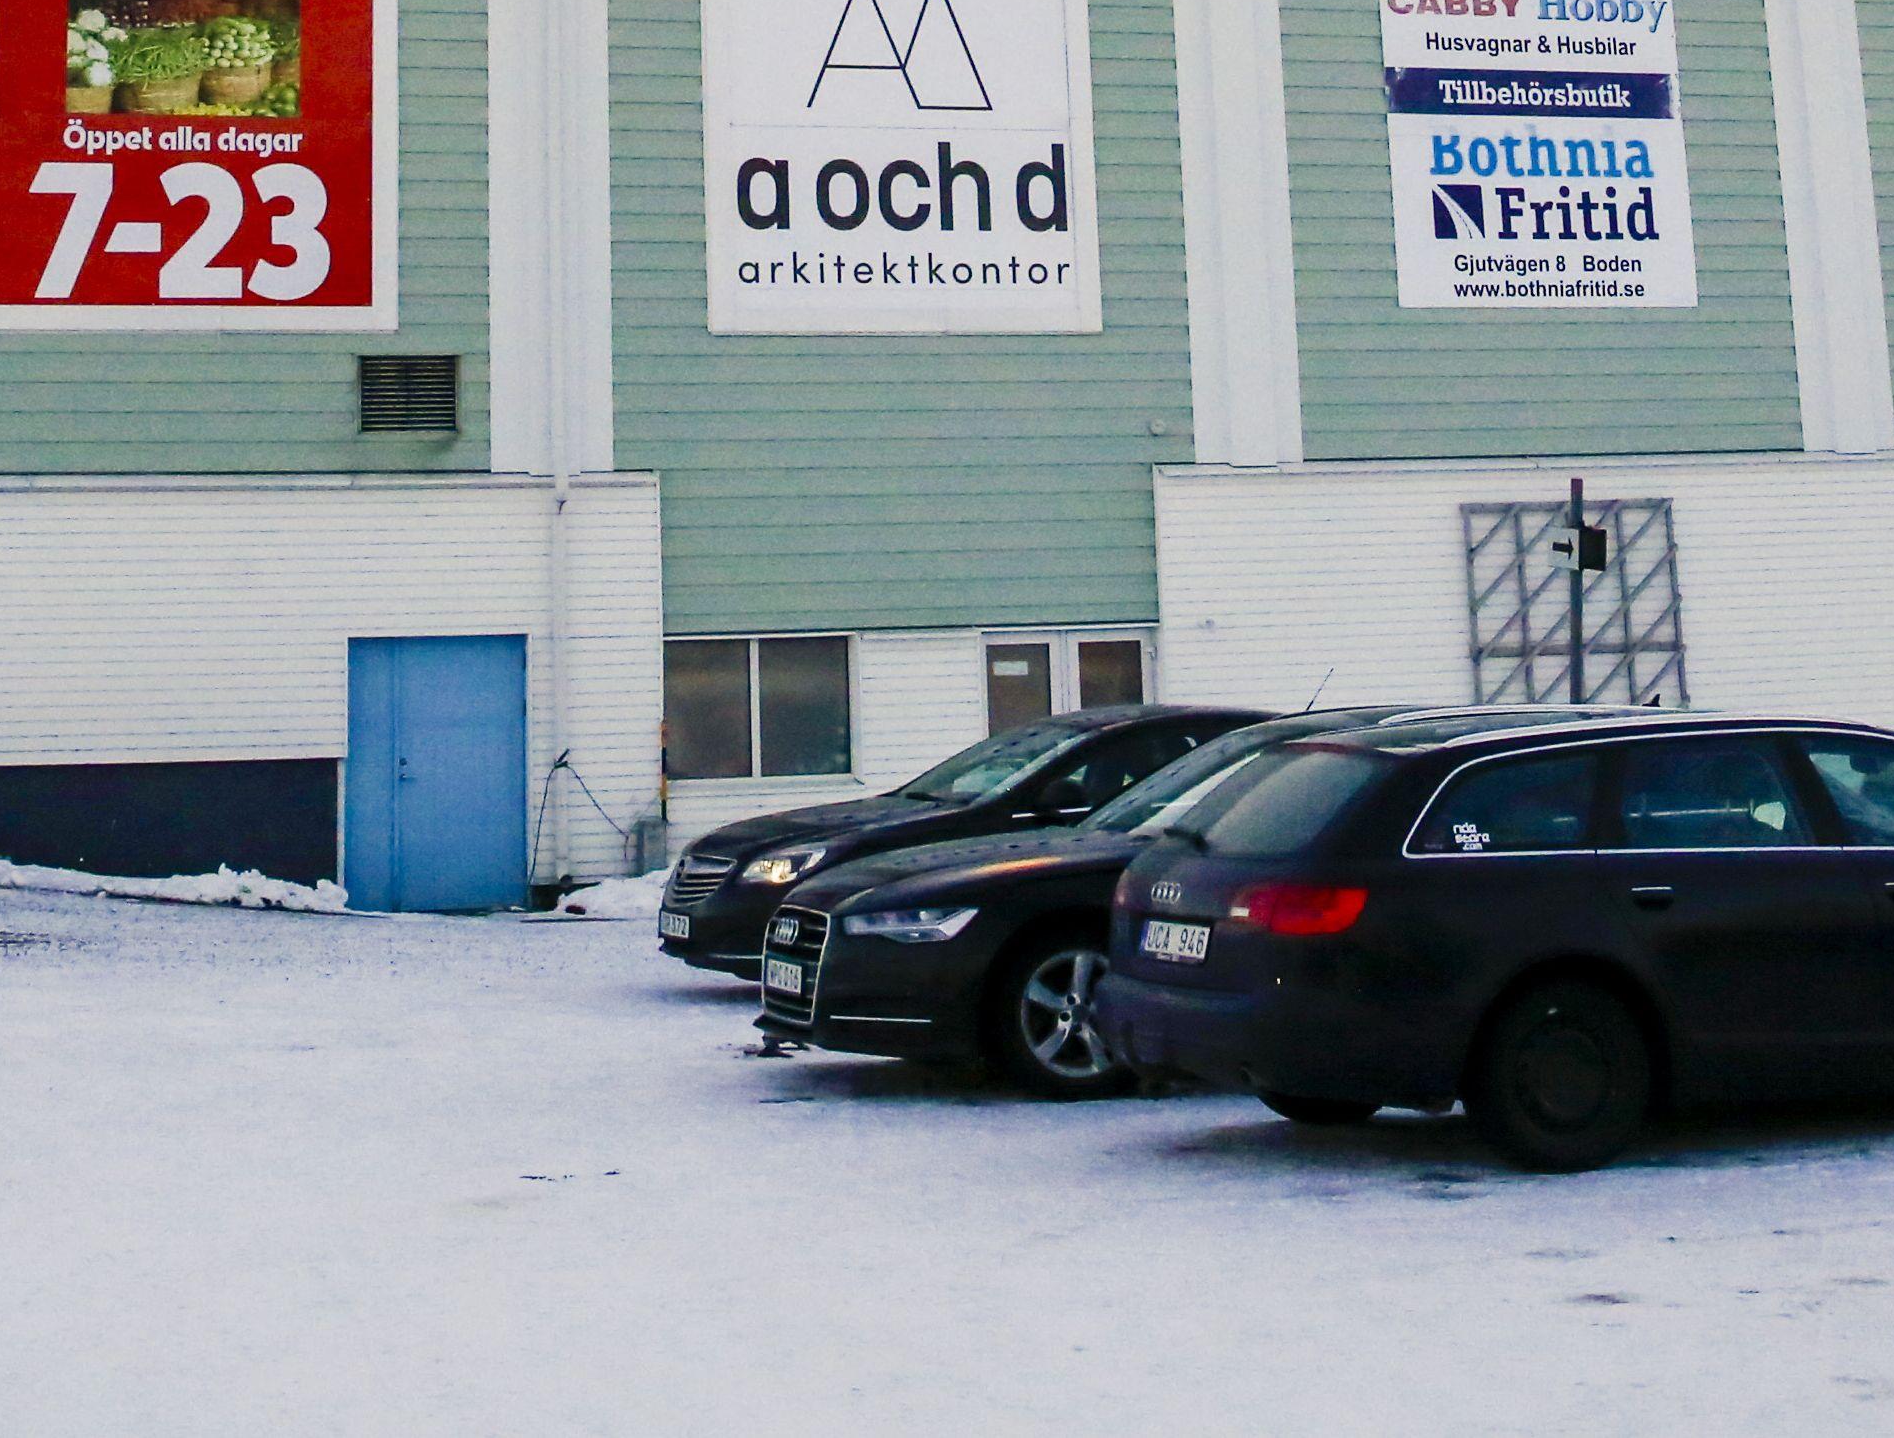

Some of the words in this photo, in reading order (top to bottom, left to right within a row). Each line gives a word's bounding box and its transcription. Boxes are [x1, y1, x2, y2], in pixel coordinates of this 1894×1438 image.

[1426, 32, 1531, 56] Husvagnar
[1538, 35, 1552, 54] &
[1557, 36, 1637, 56] Husbilar
[1439, 79, 1631, 108] Tillbehörsbutik
[62, 118, 153, 155] Öppet
[158, 127, 211, 152] alla
[217, 127, 303, 157] dagar
[1430, 132, 1654, 179] Bothnia
[736, 156, 790, 230] a
[816, 141, 992, 231] och
[1015, 143, 1069, 232] d
[1495, 186, 1660, 241] Fritid
[28, 162, 331, 300] 7-23
[738, 251, 1070, 284] arkitektkontor
[1454, 254, 1549, 275] Gjutvägen
[1556, 256, 1567, 272] 8
[1583, 256, 1642, 272] Boden
[1454, 280, 1645, 297] www.bothniafritid.se
[1178, 928, 1206, 955] 946
